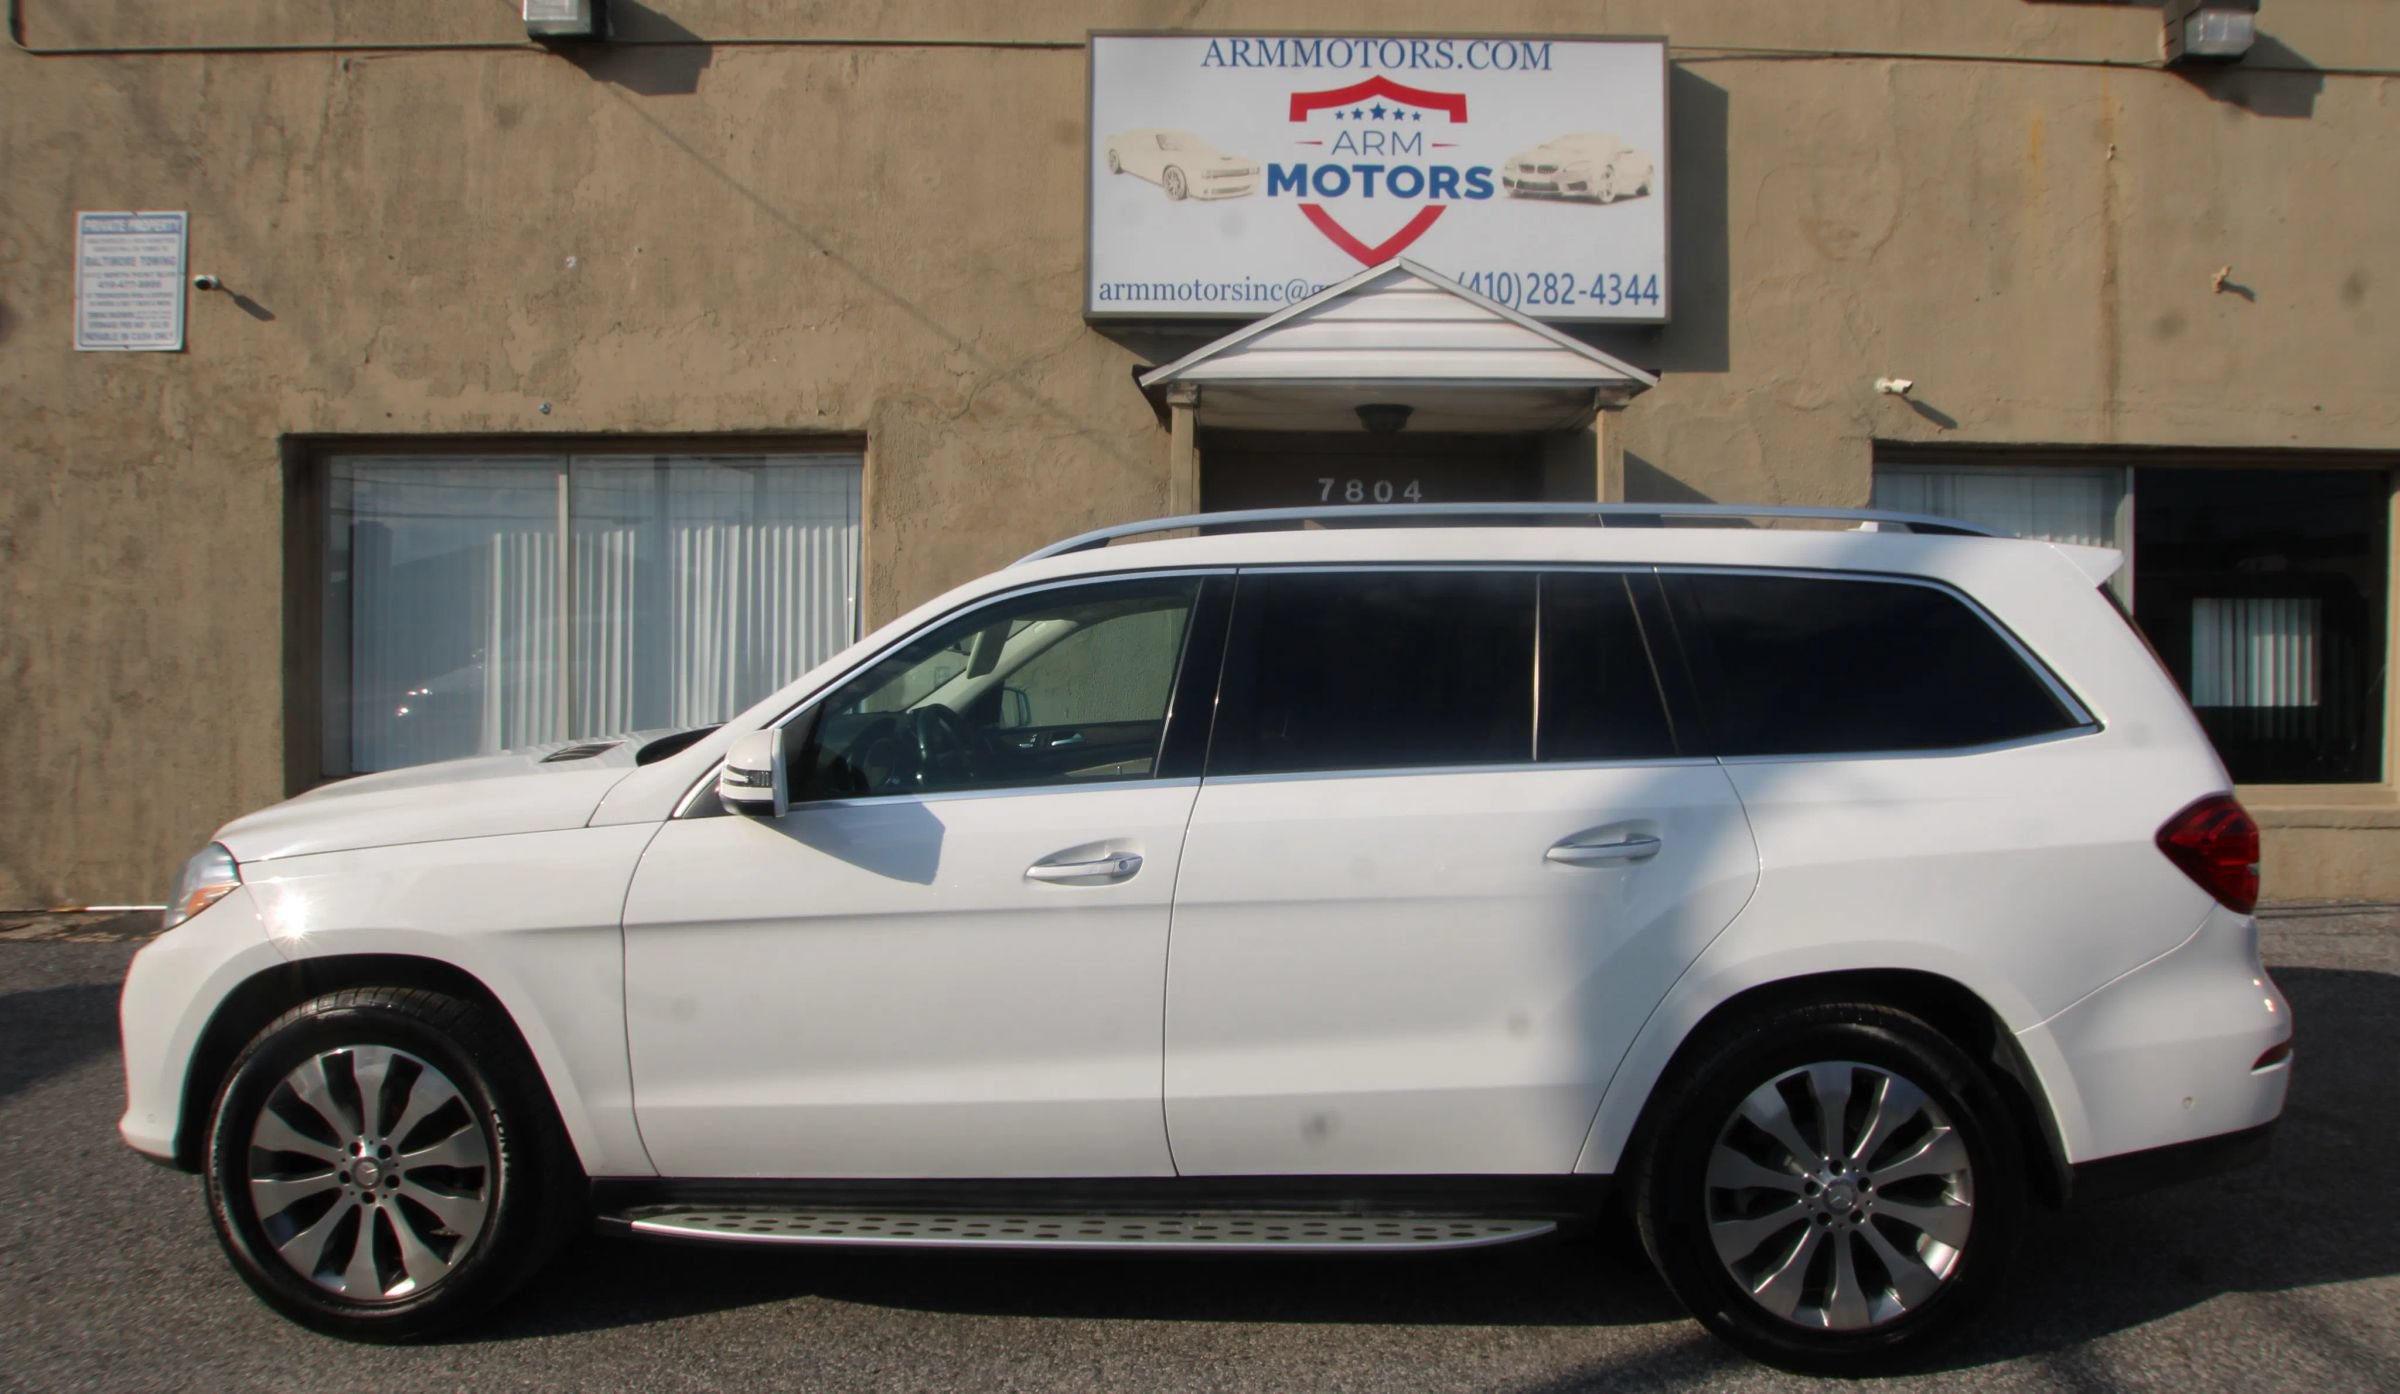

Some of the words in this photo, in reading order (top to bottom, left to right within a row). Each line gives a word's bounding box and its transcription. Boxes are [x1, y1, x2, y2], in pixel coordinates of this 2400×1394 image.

[1200, 38, 1552, 71] ARMMOTORS.COM
[1331, 130, 1422, 156] ARM
[1267, 163, 1494, 200] MOTORS
[1318, 477, 1422, 503] 7804
